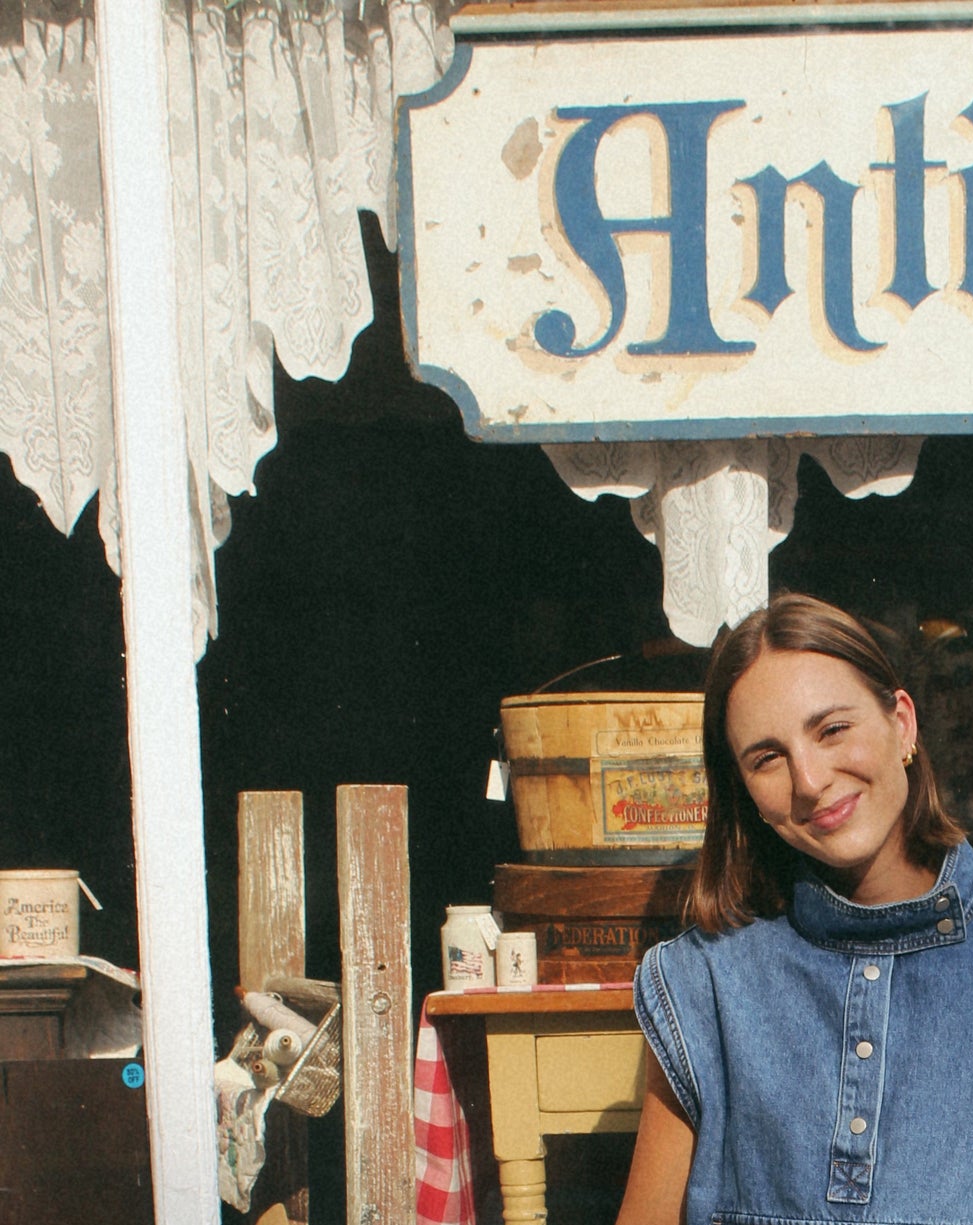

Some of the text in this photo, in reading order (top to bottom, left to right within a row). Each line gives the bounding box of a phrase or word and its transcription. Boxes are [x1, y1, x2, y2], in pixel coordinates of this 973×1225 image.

[648, 735, 690, 747] Chocolate
[3, 897, 70, 916] America
[24, 915, 49, 928] The
[5, 924, 69, 944] Beautiful
